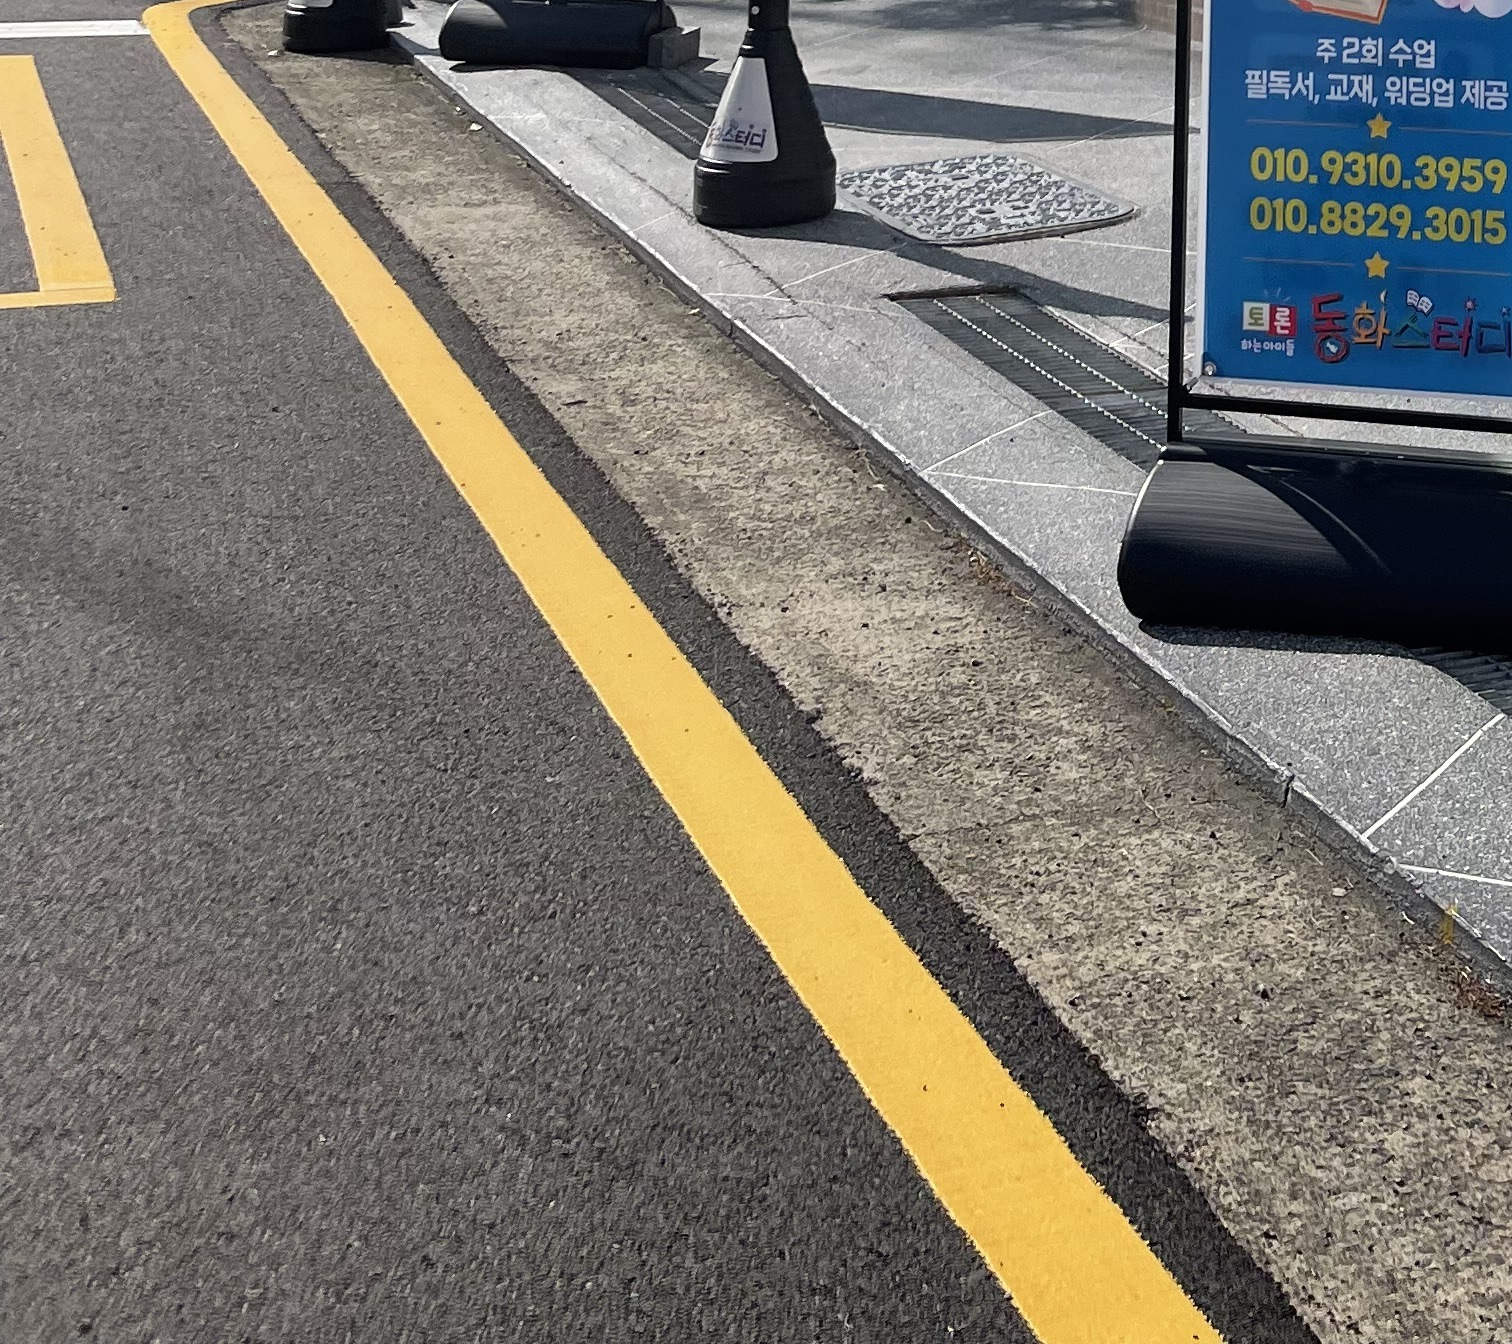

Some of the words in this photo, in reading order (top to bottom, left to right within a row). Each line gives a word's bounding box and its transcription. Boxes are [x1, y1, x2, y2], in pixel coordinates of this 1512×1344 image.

[1388, 37, 1436, 70] 수업
[1244, 69, 1320, 105] 필독서,
[1325, 73, 1379, 108] 교재,
[1384, 75, 1455, 108] 워딩업
[1460, 78, 1510, 111] 제공
[1249, 146, 1508, 194] 010.9310.3959
[1249, 196, 1507, 245] 010.8829.3015
[1246, 305, 1293, 335] 토론
[1311, 292, 1512, 363] 동화스터디
